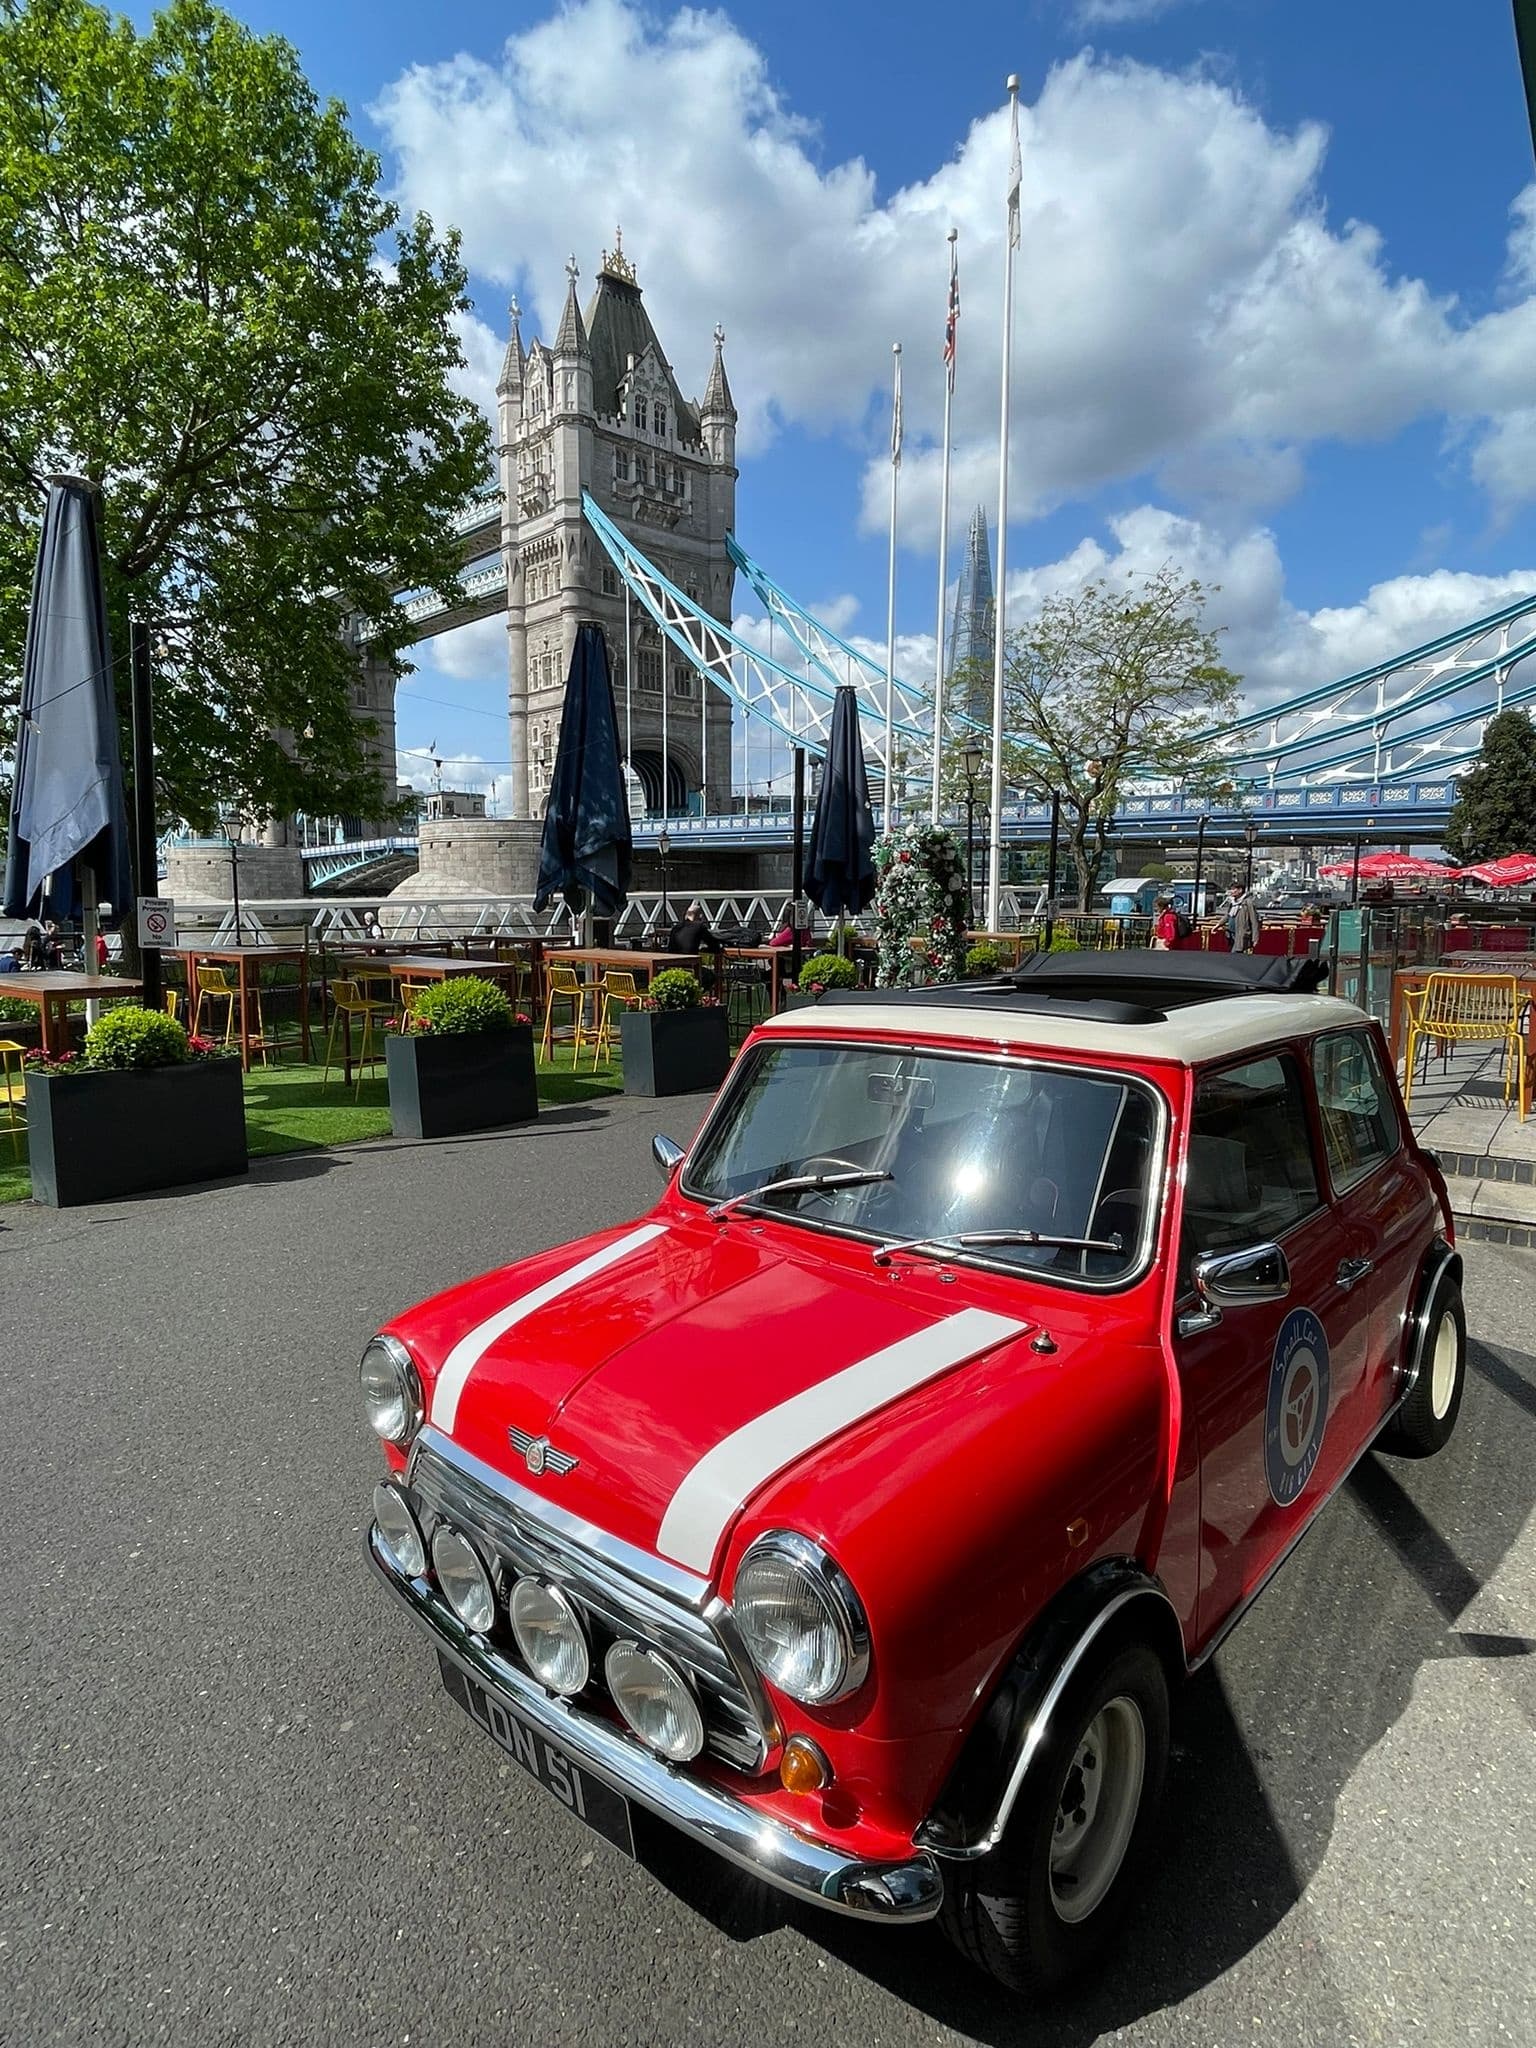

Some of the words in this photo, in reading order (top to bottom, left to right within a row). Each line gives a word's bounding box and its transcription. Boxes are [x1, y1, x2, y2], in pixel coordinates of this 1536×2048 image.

[1275, 1320, 1302, 1385] Small
[1298, 1437, 1318, 1486] CITY
[544, 1743, 586, 1819] 51
